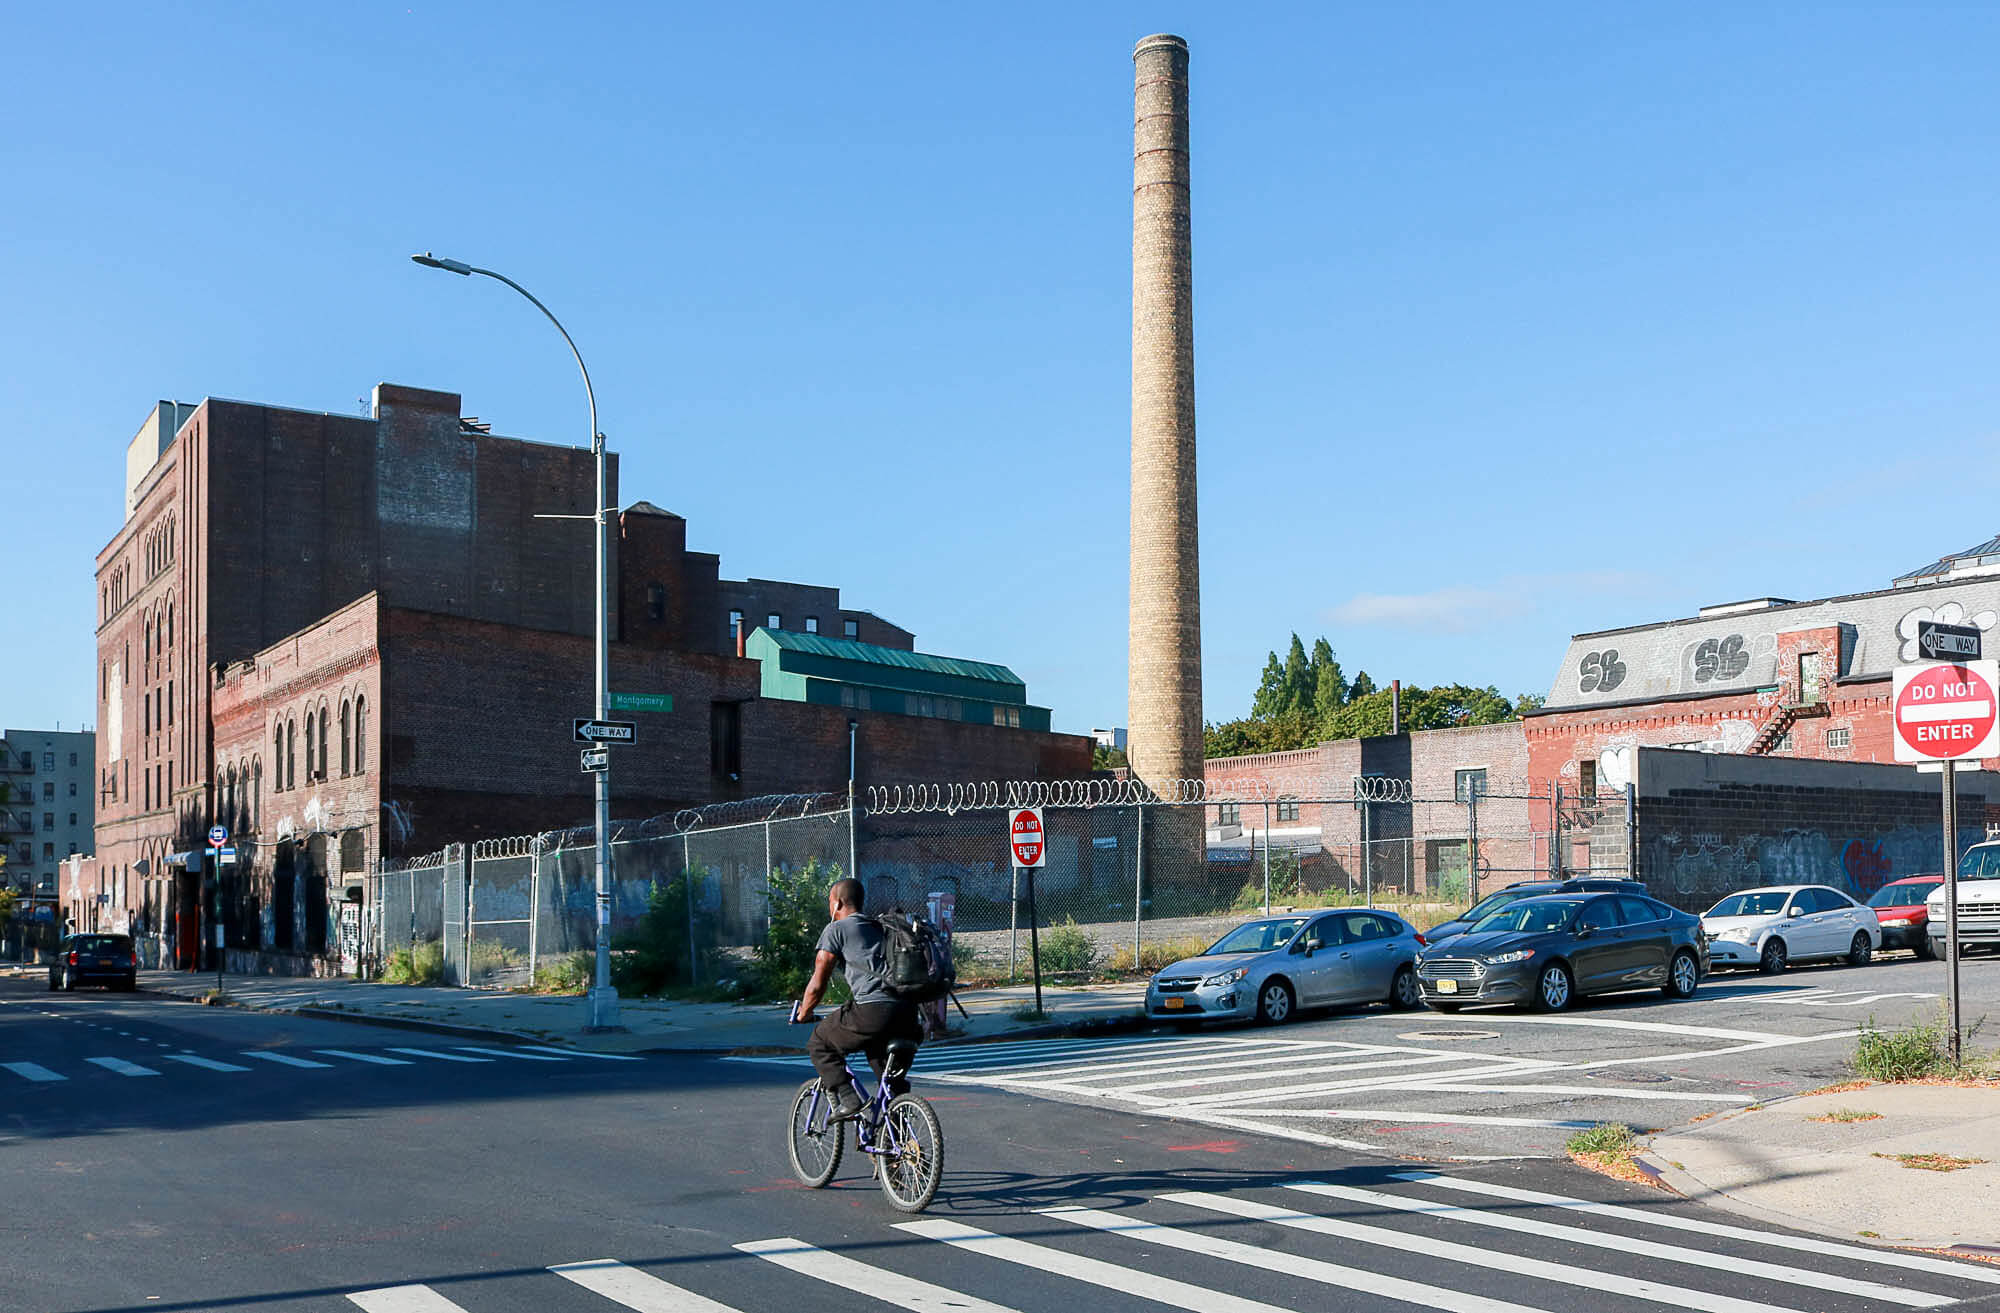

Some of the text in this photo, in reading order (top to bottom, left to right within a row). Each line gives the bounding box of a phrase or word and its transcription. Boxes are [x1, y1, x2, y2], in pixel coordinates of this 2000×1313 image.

[1925, 634, 1976, 652] ONE WAY
[1912, 681, 1977, 700] DO NOT
[616, 695, 665, 707] Montgomery
[585, 726, 628, 737] ONE WAY
[1917, 724, 1974, 742] ENTER
[1015, 821, 1038, 830] DO NOT
[1018, 846, 1038, 856] ENTER
